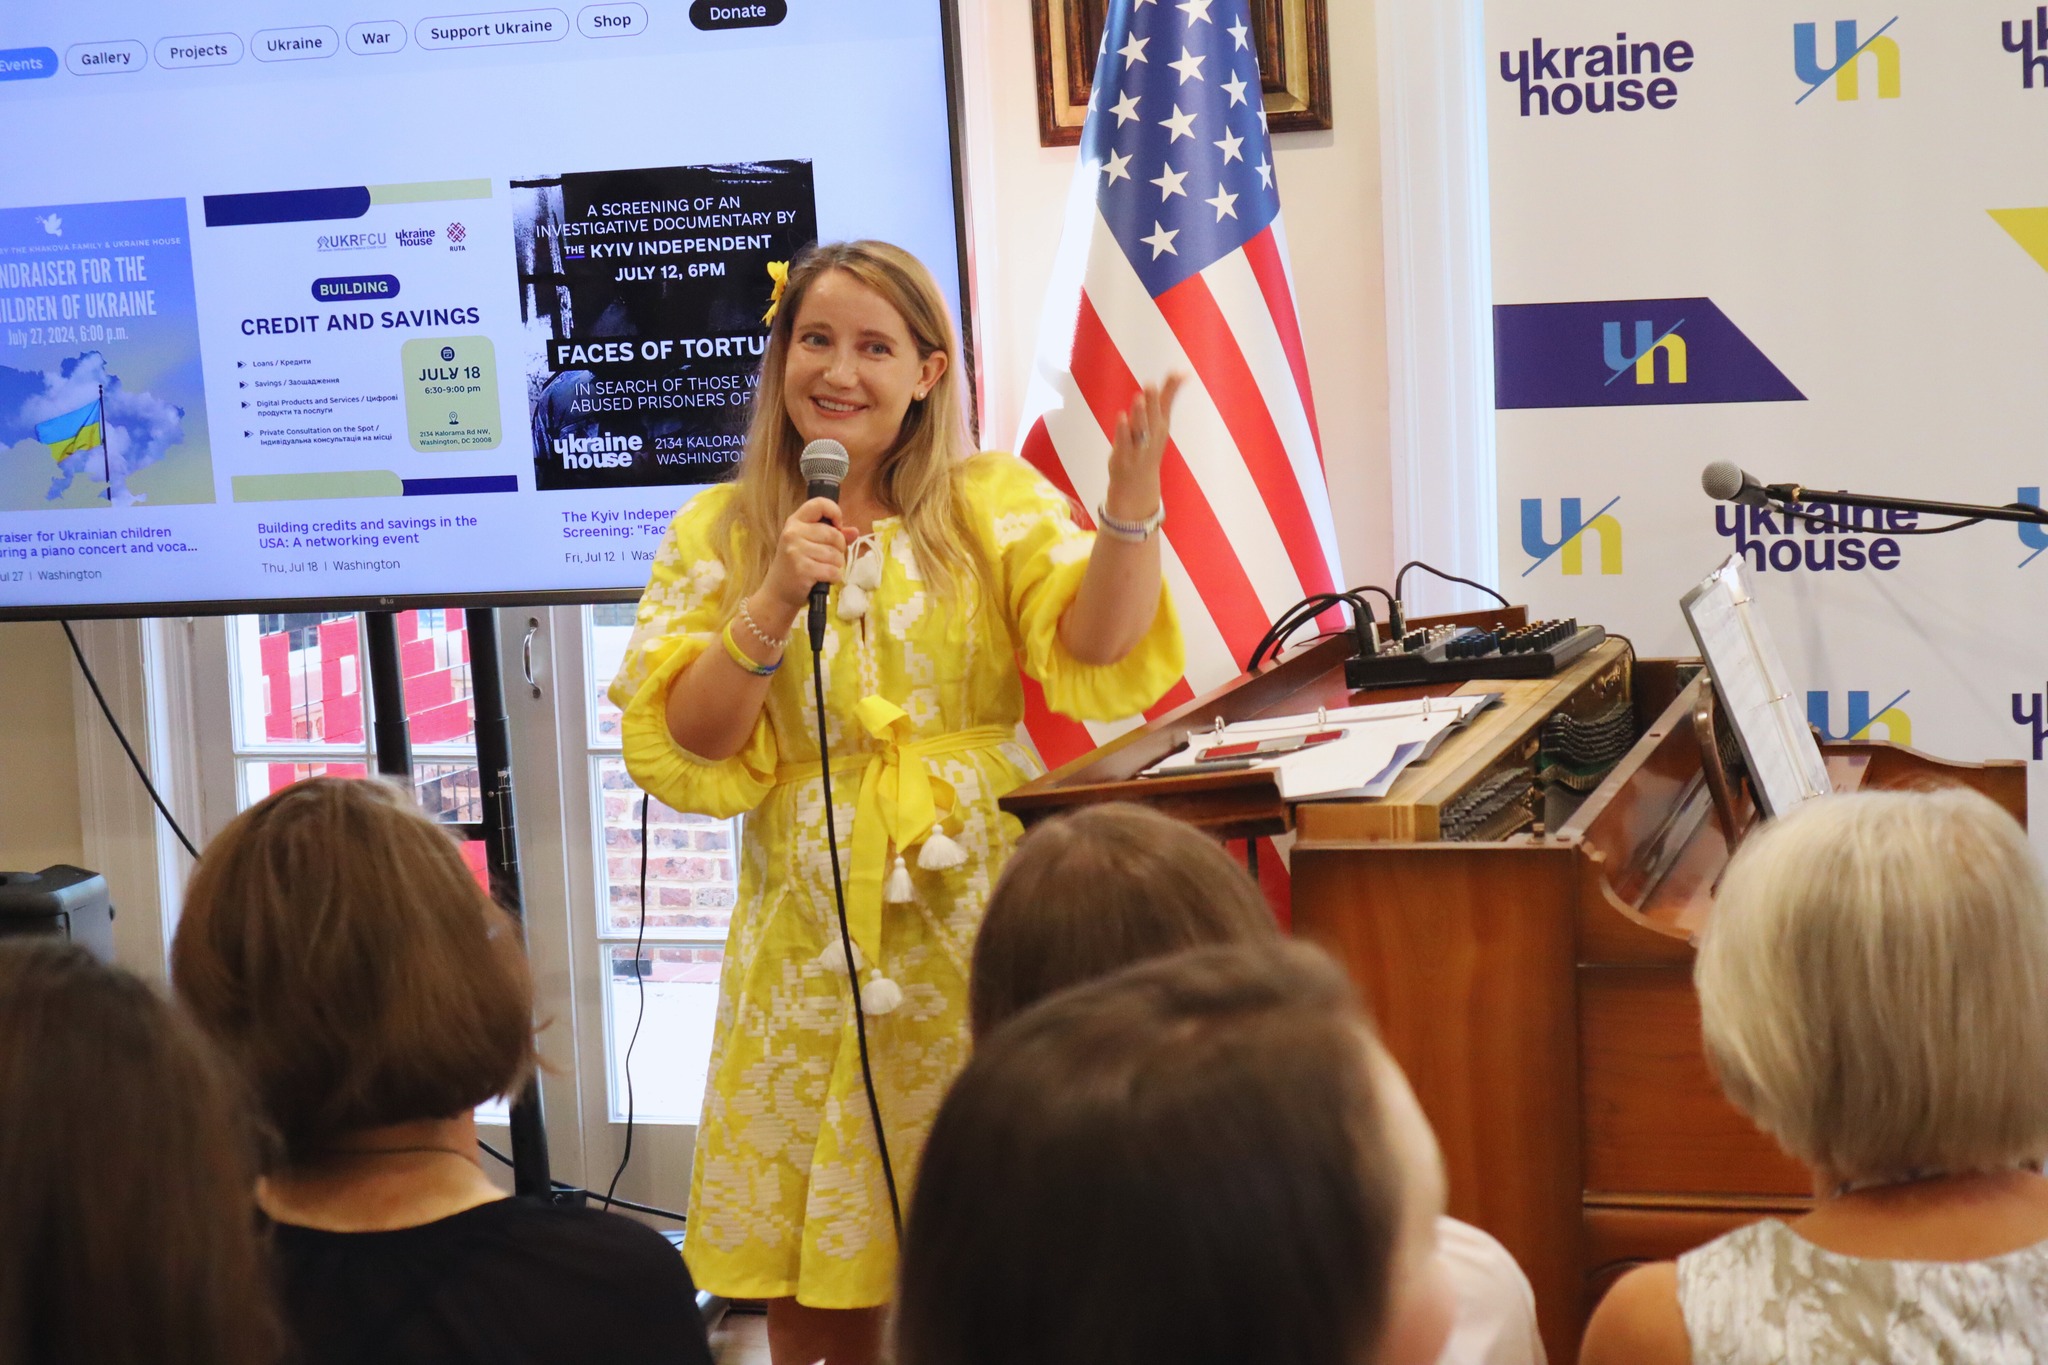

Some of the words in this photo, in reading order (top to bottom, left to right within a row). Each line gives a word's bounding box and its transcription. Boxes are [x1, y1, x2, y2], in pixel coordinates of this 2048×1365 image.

[710, 4, 766, 21] Donate
[594, 13, 631, 29] Shop
[362, 31, 390, 45] War
[431, 23, 490, 42] Support
[495, 20, 552, 35] Ukraine
[170, 43, 228, 60] Projects
[267, 36, 322, 52] Ukraine
[0, 58, 43, 72] Events
[81, 51, 131, 66] Gallery
[1500, 32, 1694, 82] ukraine
[1519, 77, 1678, 117] house
[587, 204, 598, 217] A
[602, 199, 689, 216] SCREENING
[693, 197, 713, 211] OF
[719, 196, 740, 209] AN
[536, 219, 648, 238] INVESTIGATIVE
[653, 212, 771, 232] DOCUMENTARY
[777, 210, 796, 223] BY
[330, 233, 387, 247] UKRFCU
[395, 228, 435, 239] ukraine
[113, 239, 150, 248] UKRAINE
[152, 237, 181, 246] HOUSE
[400, 237, 433, 247] house
[564, 245, 585, 255] THE
[590, 239, 633, 258] KYIV
[638, 234, 772, 256] INDEPENDENT
[81, 257, 112, 285] FOR
[115, 256, 147, 282] THE
[615, 266, 655, 282] JULY
[660, 266, 683, 281] 12,
[688, 262, 725, 277] 6PM
[320, 281, 388, 296] BUILDING
[62, 294, 80, 320] OF
[85, 290, 157, 319] UKRAINE
[241, 315, 320, 336] CREDIT
[327, 312, 374, 331] AND
[381, 307, 480, 329] SAVINGS
[8, 329, 28, 349] July
[31, 327, 47, 346] 27,
[49, 326, 79, 345] 2024,
[80, 325, 104, 342] 6:00
[107, 327, 129, 344] p.m.
[557, 342, 634, 365] FACES
[641, 340, 673, 361] OF
[680, 336, 771, 358] TORTU
[280, 359, 311, 367] Кредити
[419, 367, 458, 381] JULY
[464, 366, 480, 379] 18
[255, 380, 282, 388] Savings
[288, 377, 340, 386] Заощадження
[425, 386, 465, 394] 6:30-9:00
[575, 383, 590, 396] IN
[596, 380, 657, 395] SEARCH
[662, 378, 683, 391] OF
[687, 375, 740, 390] THOSE
[257, 400, 280, 408] Digital
[281, 398, 313, 406] Products
[330, 396, 360, 404] Services
[366, 394, 398, 402] Цифрові
[570, 399, 632, 413] ABUSED
[638, 393, 725, 409] PRISONERS
[730, 392, 751, 405] OF
[258, 409, 292, 417] продукти
[303, 407, 333, 415] послуги
[286, 427, 331, 435] Consultation
[357, 425, 374, 433] Spot
[261, 438, 312, 446] Індивідуальна
[313, 435, 361, 444] консультація
[554, 432, 643, 453] ukraine
[655, 437, 683, 450] 2134
[563, 451, 632, 469] house
[562, 511, 587, 522] The
[592, 510, 619, 523] Kyiv
[258, 521, 308, 535] Building
[312, 519, 357, 533] credits
[360, 517, 384, 530] and
[387, 517, 436, 532] savings
[440, 516, 452, 528] in
[455, 515, 477, 527] the
[563, 525, 634, 539] Screening:
[37, 530, 55, 541] for
[58, 529, 117, 541] Ukrainian
[121, 527, 172, 539] children
[259, 537, 289, 549] USA:
[293, 536, 302, 548] A
[305, 534, 379, 549] networking
[383, 533, 419, 545] event
[31, 548, 37, 556] a
[41, 545, 75, 558] piano
[79, 543, 126, 556] concert
[131, 541, 153, 553] and
[565, 552, 583, 564] Fri,
[585, 552, 601, 563] Jul
[605, 551, 615, 562] 12
[1736, 538, 1901, 572] house
[288, 562, 306, 573] Jul
[307, 561, 318, 572] 18
[333, 559, 400, 574] Washington
[12, 571, 23, 581] 27
[38, 569, 102, 581] Washington
